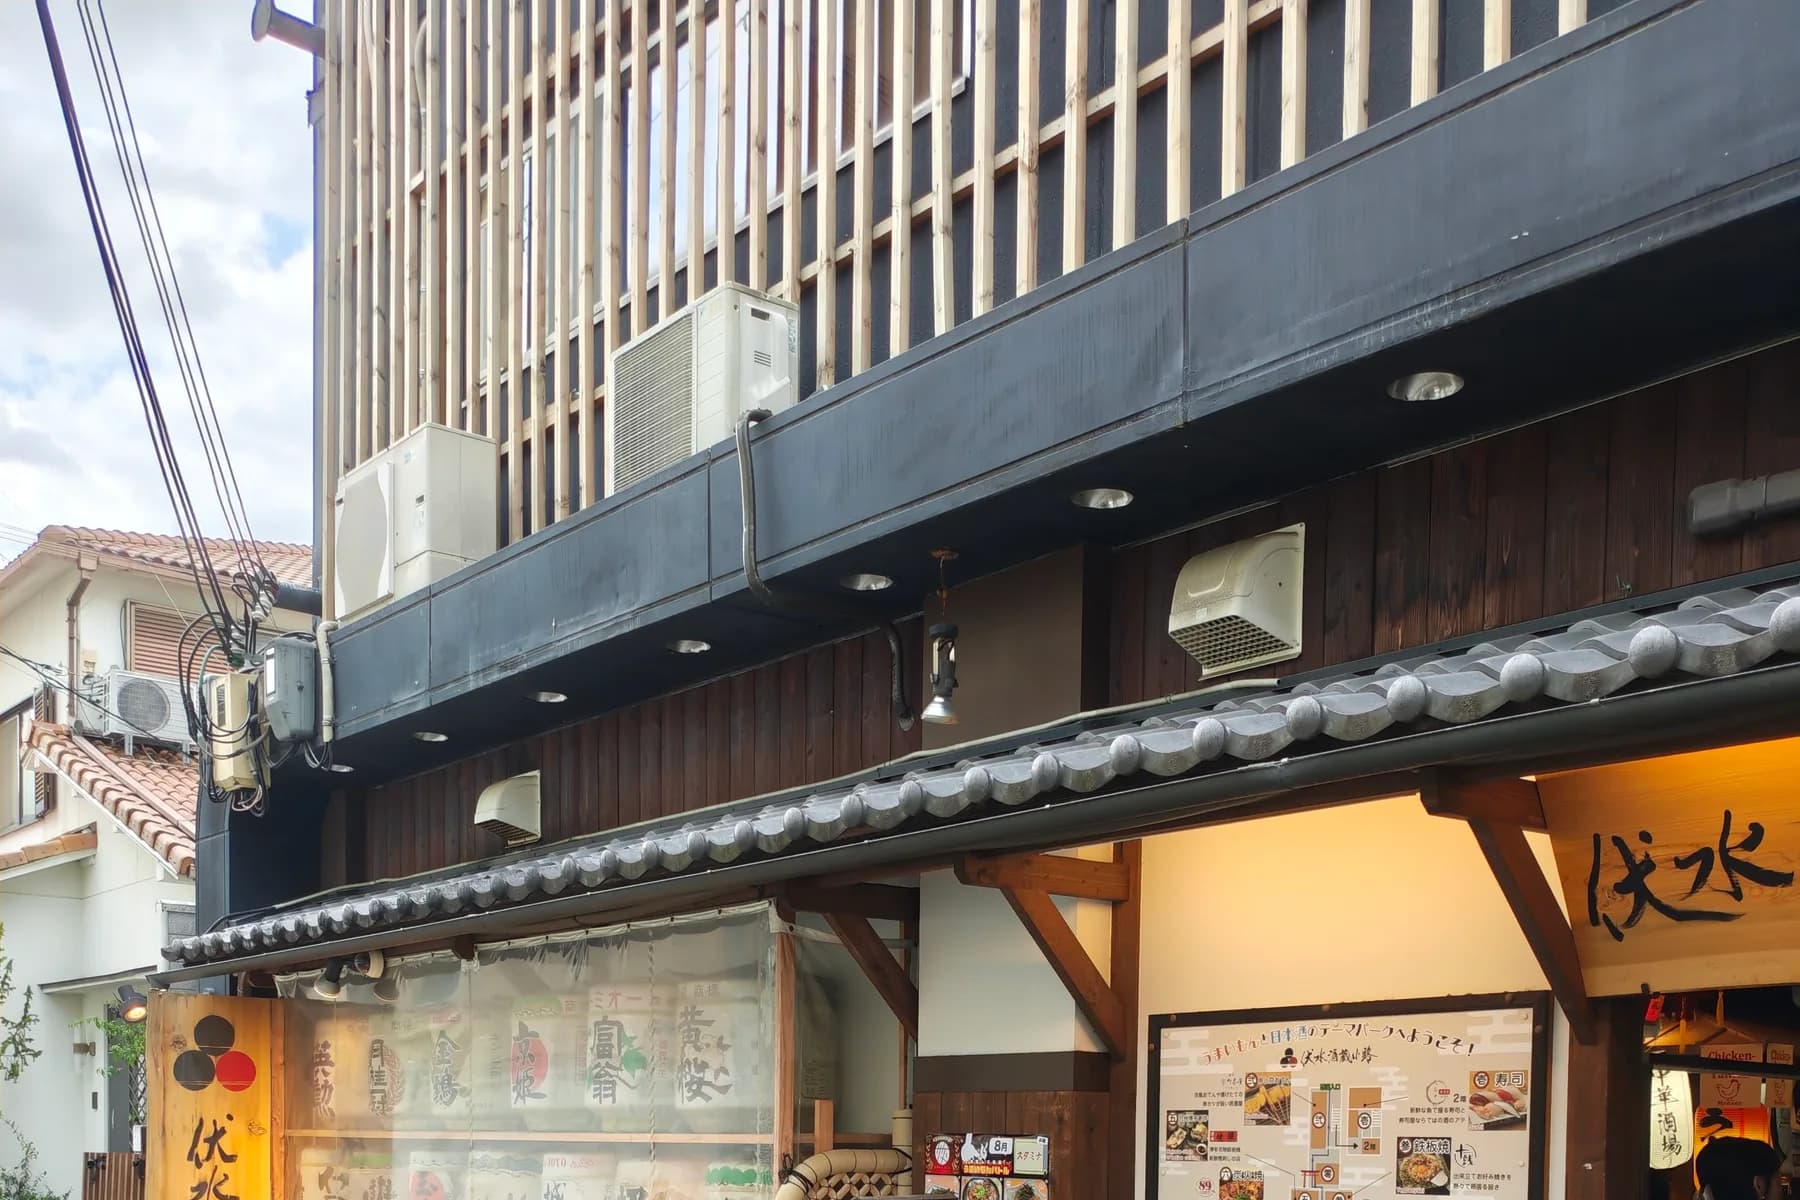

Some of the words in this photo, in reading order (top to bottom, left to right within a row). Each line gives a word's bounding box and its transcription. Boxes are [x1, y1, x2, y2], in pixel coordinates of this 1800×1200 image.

[1588, 809, 1794, 941] 伏水
[511, 1020, 548, 1105] 京姫
[1495, 1072, 1523, 1087] 寿司
[993, 1139, 1009, 1152] 8月
[1413, 1139, 1450, 1153] 鉄板焼
